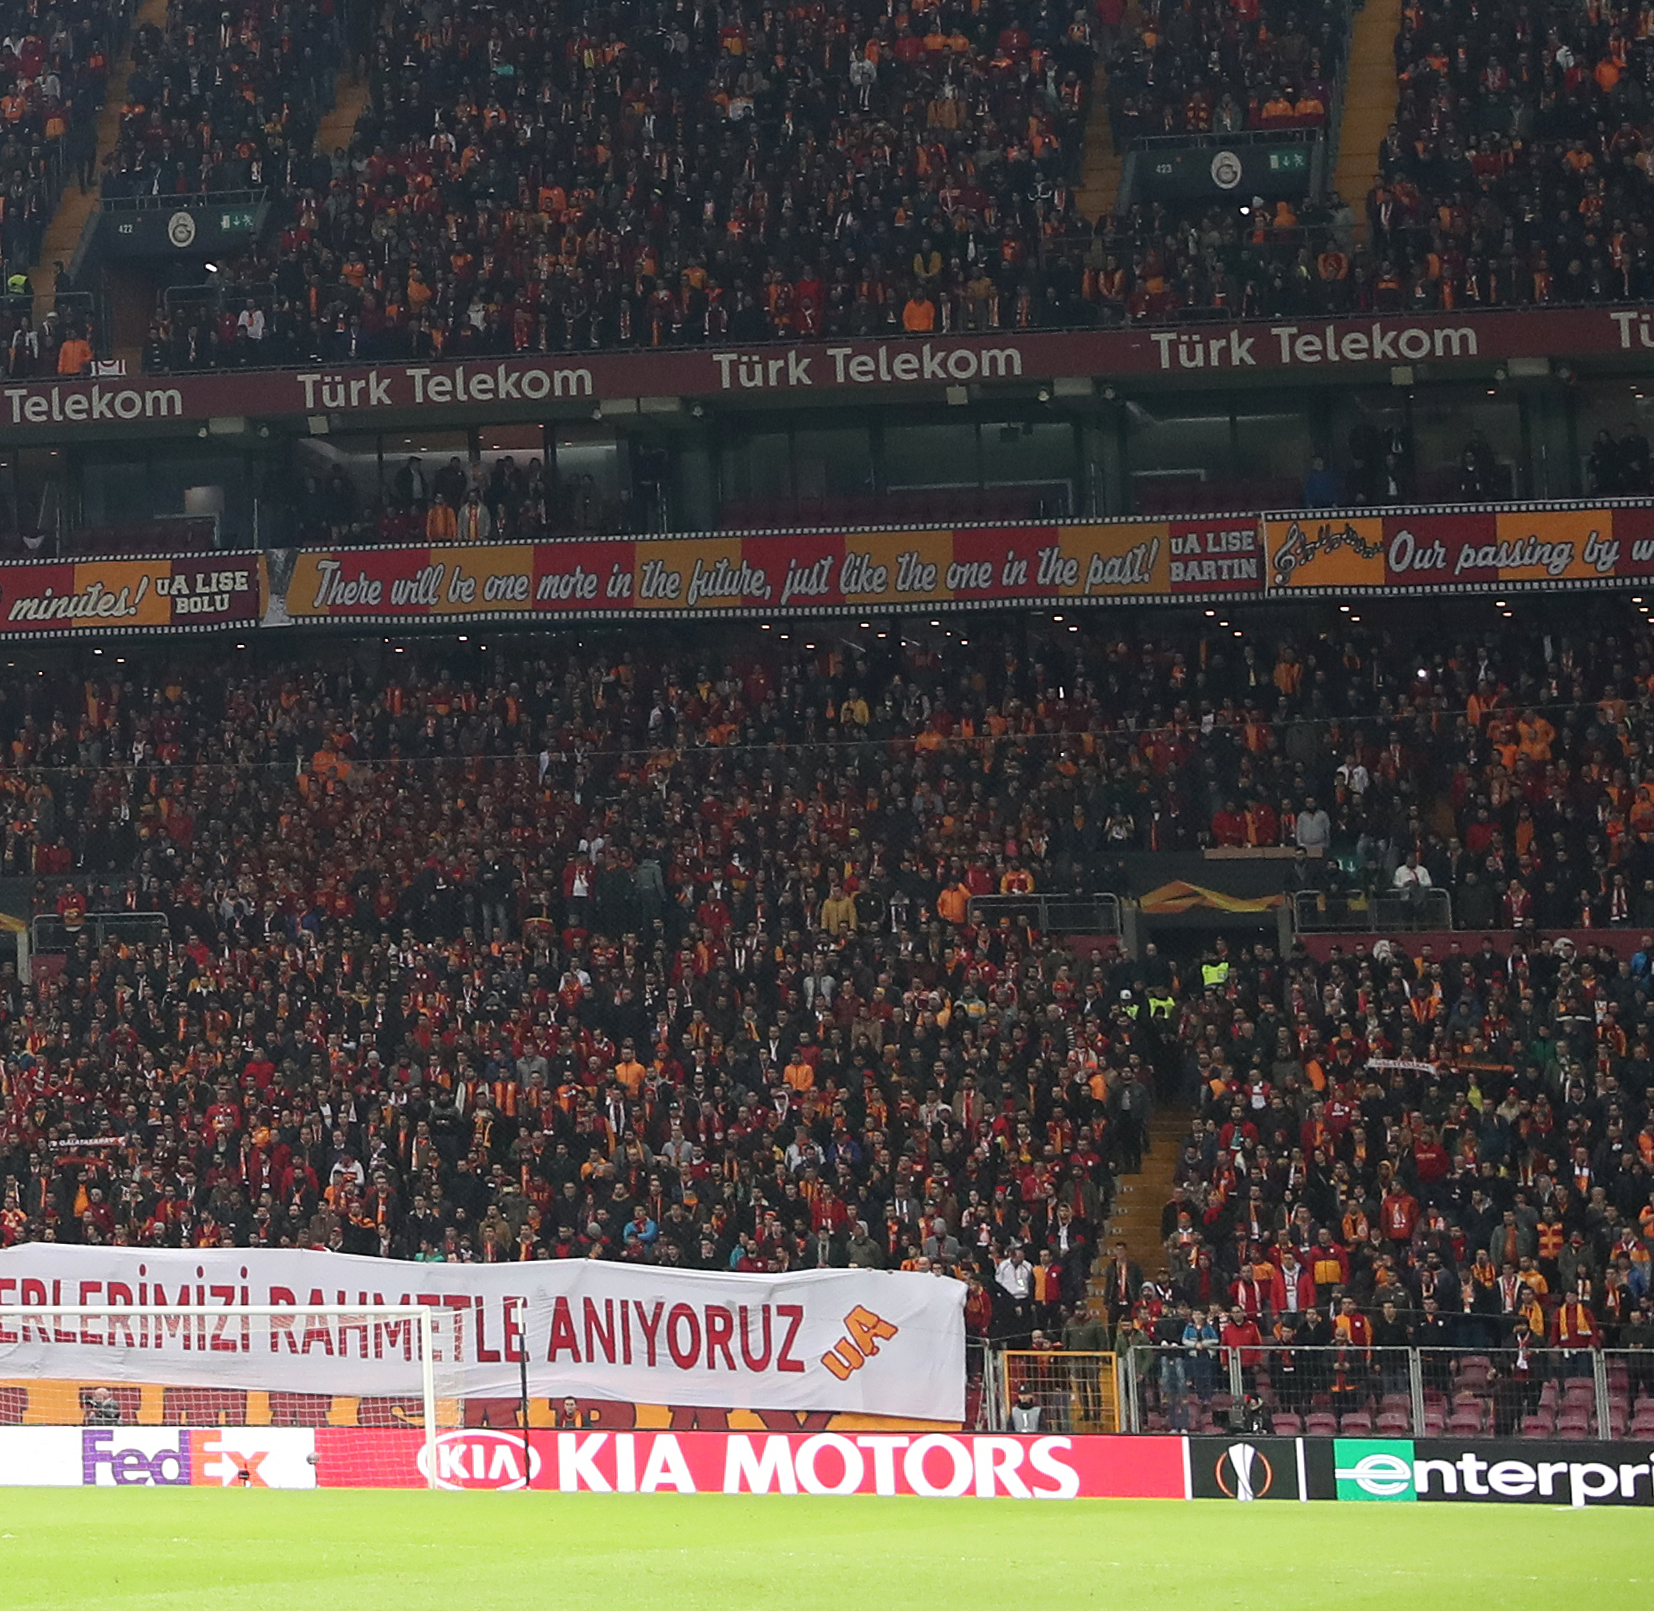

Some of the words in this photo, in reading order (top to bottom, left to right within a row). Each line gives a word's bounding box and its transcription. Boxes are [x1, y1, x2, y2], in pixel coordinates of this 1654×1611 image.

[713, 350, 812, 388] Türk
[827, 344, 1021, 382] Telekom
[1151, 330, 1256, 368] Türk
[1271, 323, 1477, 363] Telekom
[4, 383, 182, 422] Telekom
[297, 371, 391, 408] Türk
[406, 364, 592, 402] Telekom
[1206, 530, 1256, 554] LISE
[1388, 530, 1447, 573] Our
[1454, 536, 1572, 576] passing
[1583, 532, 1620, 572] by
[195, 570, 249, 594] LISE
[313, 560, 382, 607] There
[390, 564, 445, 606] will
[448, 566, 475, 603] be
[484, 575, 529, 601] one
[536, 565, 598, 600] more
[606, 562, 632, 598] in
[640, 560, 680, 599] the
[687, 558, 772, 606] future,
[780, 555, 835, 604] just
[839, 553, 887, 594] like
[896, 552, 936, 592] the
[946, 562, 993, 590] one
[1001, 550, 1028, 587] in
[1036, 547, 1078, 586] the
[1084, 538, 1159, 594] past!
[1170, 558, 1258, 582] BARTIN
[7, 576, 149, 621] minutes!
[171, 591, 230, 614] BOLU
[547, 1292, 806, 1374] ANIYORUZ
[83, 1430, 270, 1487] FedEx
[438, 1443, 520, 1481] KIA
[559, 1433, 695, 1493] KIA
[723, 1432, 1081, 1500] MOTORS
[1335, 1452, 1654, 1507] enterpr
